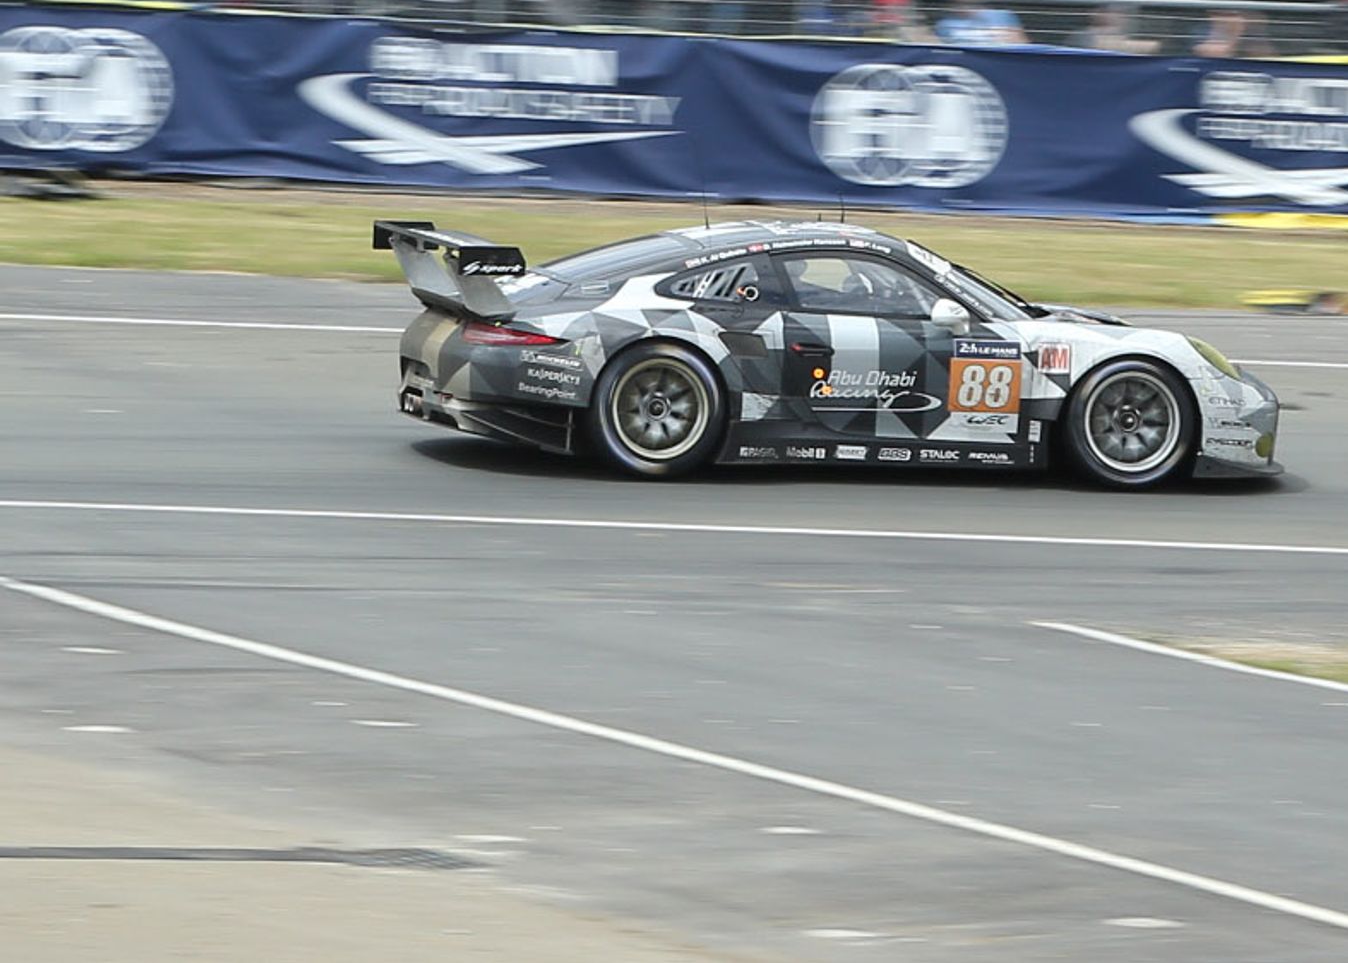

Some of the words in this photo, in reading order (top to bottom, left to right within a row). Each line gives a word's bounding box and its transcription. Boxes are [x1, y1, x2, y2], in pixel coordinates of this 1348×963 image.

[1041, 347, 1069, 369] AM
[827, 369, 862, 386] Abu
[865, 369, 918, 387] Dhabi
[957, 364, 1013, 408] 88
